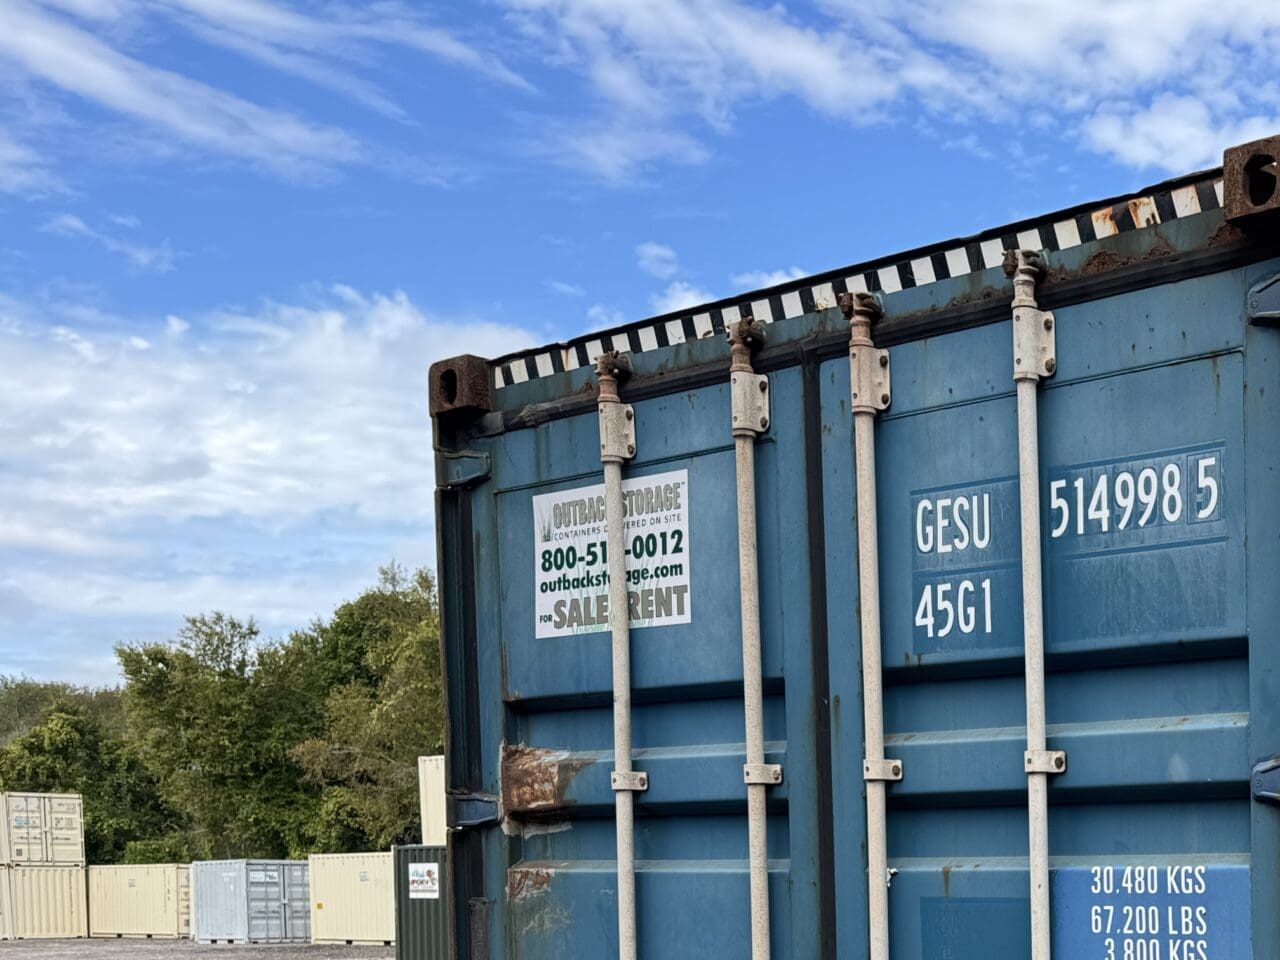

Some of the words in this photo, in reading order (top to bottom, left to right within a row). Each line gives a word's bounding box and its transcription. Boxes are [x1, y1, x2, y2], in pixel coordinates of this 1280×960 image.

[552, 495, 608, 529] OUTBAC
[916, 493, 990, 553] GESU
[1051, 463, 1182, 538] 514998
[1197, 456, 1218, 519] 5
[554, 526, 601, 541] CONTAINERS
[649, 517, 661, 526] ON
[664, 513, 682, 524] SITE
[541, 529, 683, 572] 800-51-0012
[540, 563, 683, 593] outbackstage.com
[540, 614, 553, 624] FOR
[553, 594, 609, 629] SALE
[627, 584, 688, 620] RENT
[915, 578, 992, 638] 45G1
[1167, 866, 1206, 894] KGS
[1168, 906, 1207, 935] LBS
